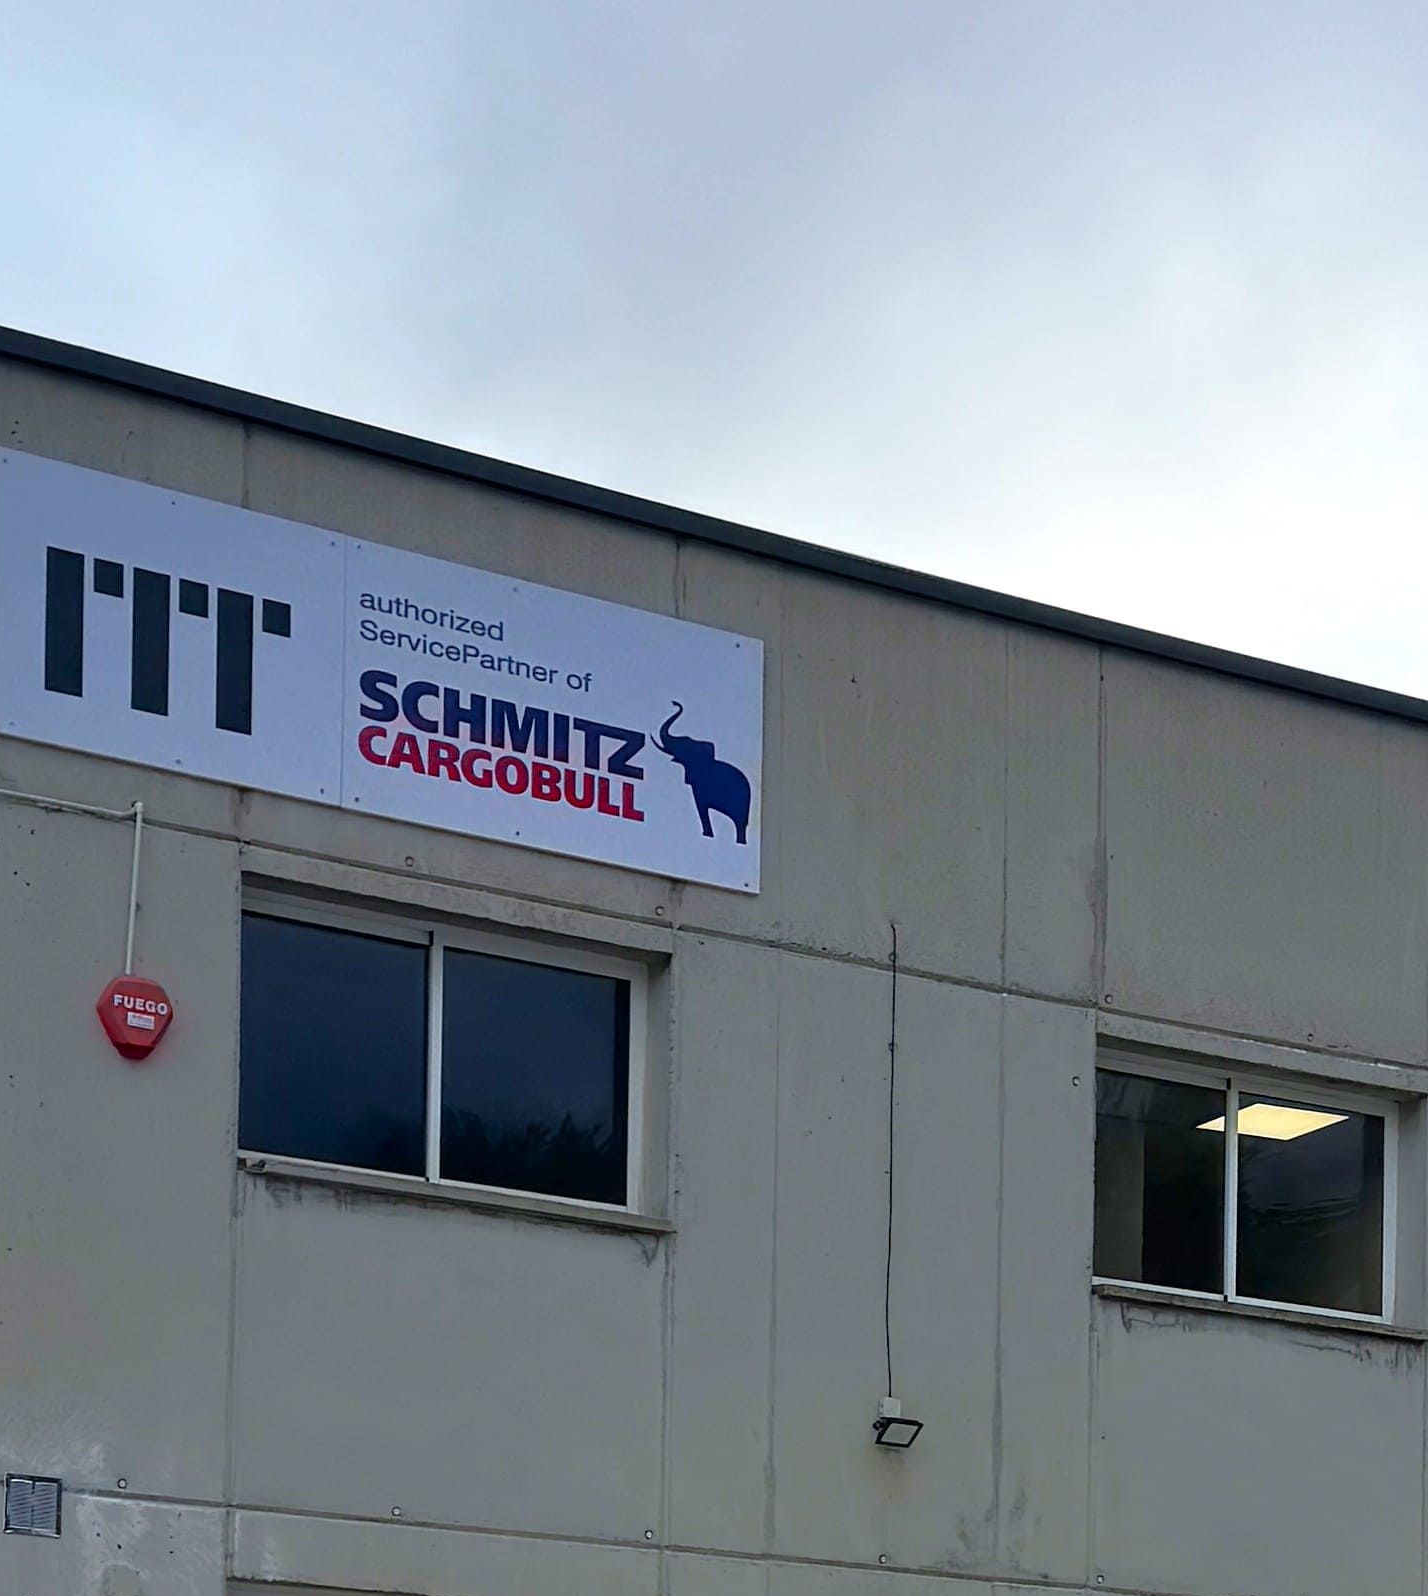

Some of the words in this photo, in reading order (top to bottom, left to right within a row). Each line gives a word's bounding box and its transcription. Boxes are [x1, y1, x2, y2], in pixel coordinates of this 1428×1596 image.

[359, 592, 504, 641] authorized
[359, 619, 559, 685] ServicePartner
[565, 672, 593, 693] of
[358, 669, 646, 780] SCHMITZ
[357, 725, 645, 822] CARGOBULL
[113, 993, 169, 1016] FUEGO
